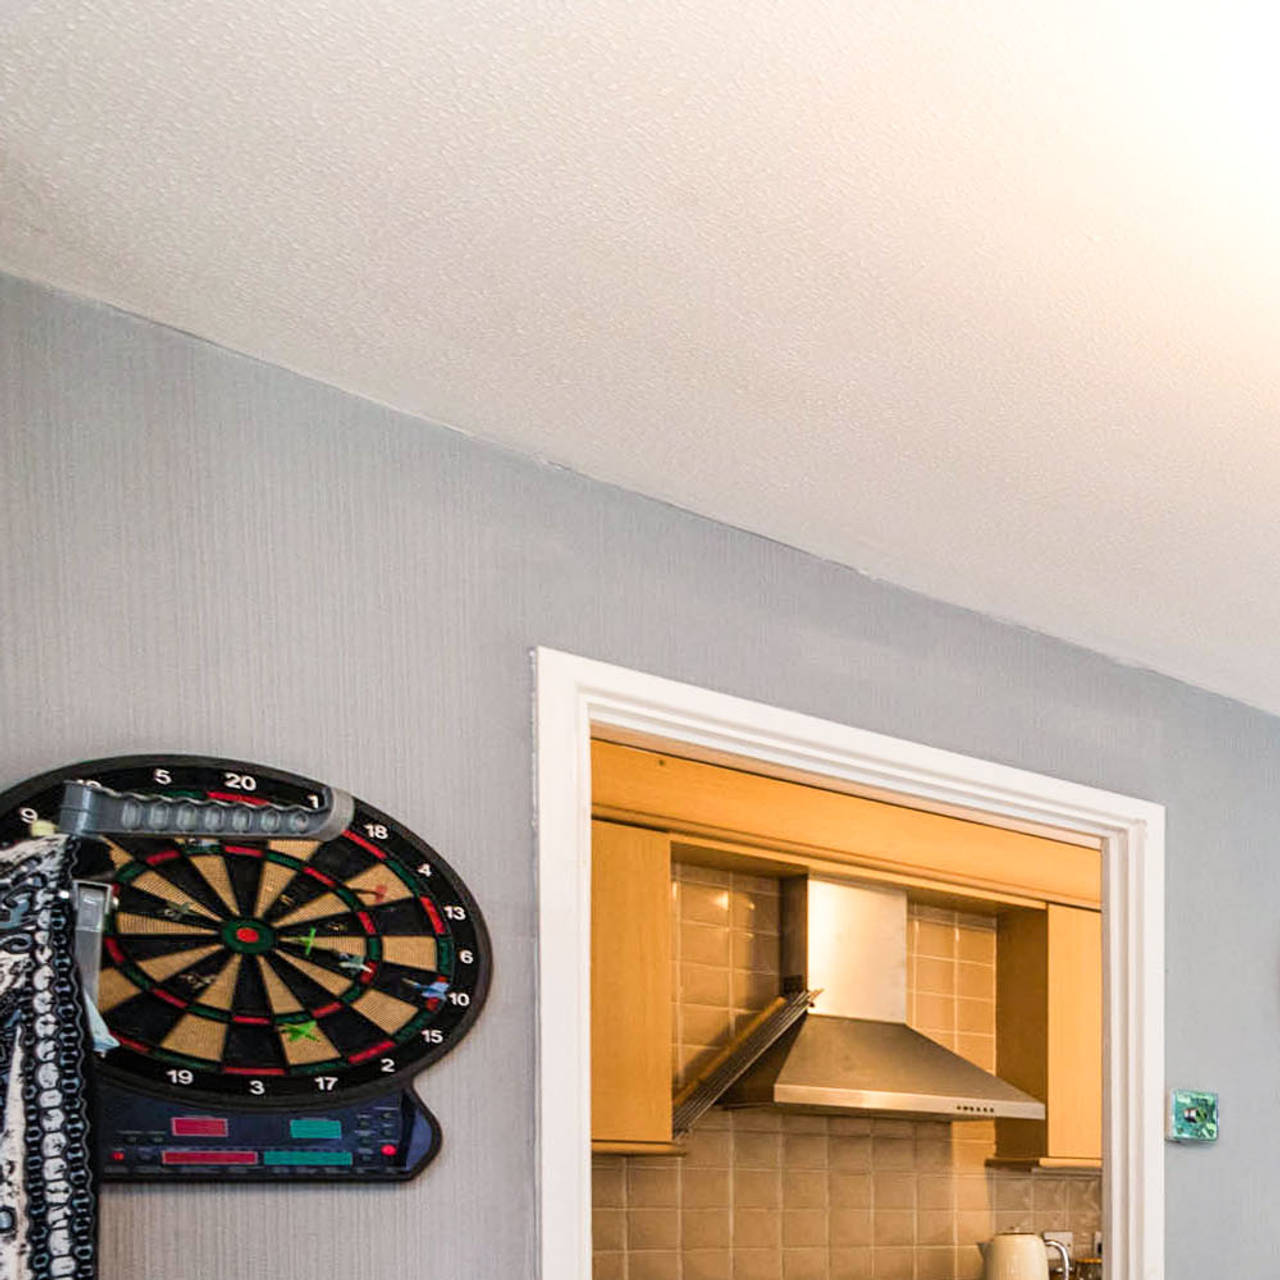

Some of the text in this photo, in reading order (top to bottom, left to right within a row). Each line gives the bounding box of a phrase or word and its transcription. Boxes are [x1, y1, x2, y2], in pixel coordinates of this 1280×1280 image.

[153, 768, 172, 785] 5
[223, 772, 257, 791] 20
[20, 807, 39, 824] 9
[365, 823, 389, 840] 18
[417, 862, 432, 877] 4
[444, 905, 466, 921] 13
[459, 949, 474, 964] 6
[448, 992, 470, 1008] 10
[421, 1029, 443, 1044] 15
[381, 1058, 395, 1073] 2
[166, 1069, 194, 1085] 19
[314, 1075, 338, 1091] 17
[249, 1080, 266, 1095] 3
